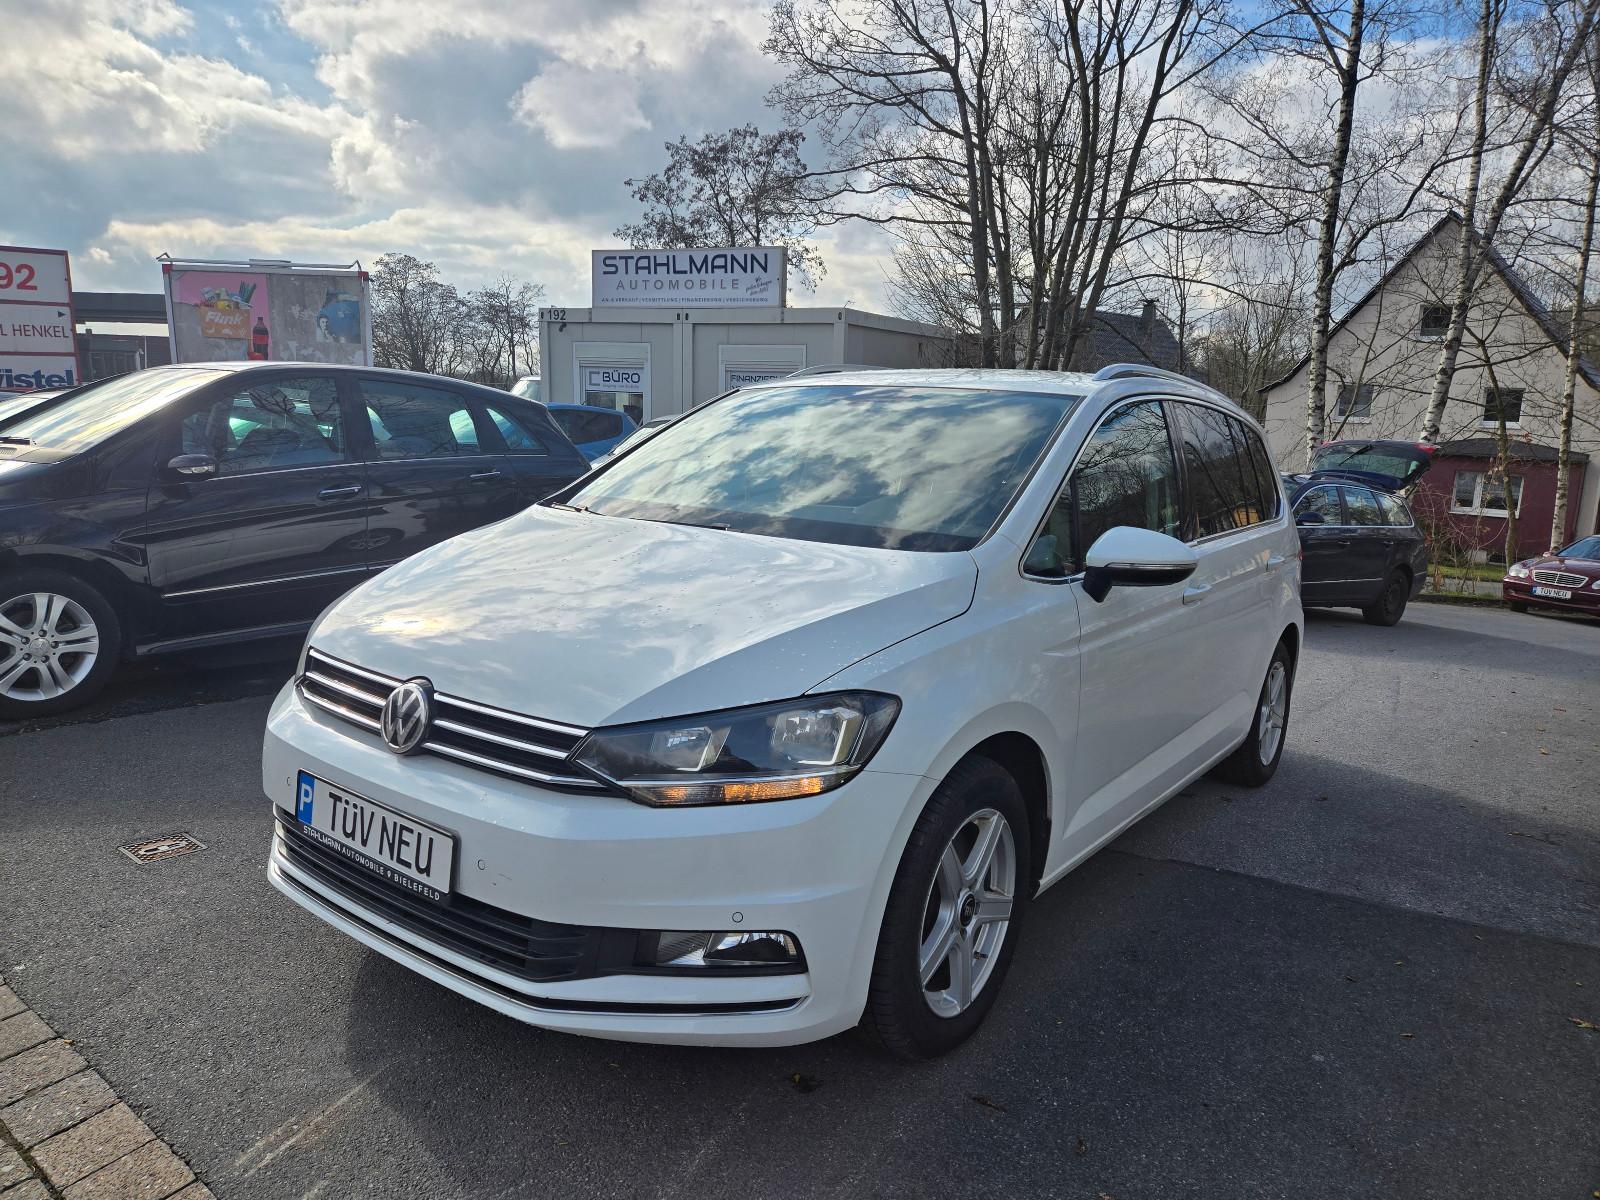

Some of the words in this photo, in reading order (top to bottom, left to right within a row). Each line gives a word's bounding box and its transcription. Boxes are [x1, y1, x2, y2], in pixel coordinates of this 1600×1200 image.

[602, 253, 768, 275] STAHLMANN
[616, 278, 740, 291] AUTOMOBILE
[547, 309, 566, 321] 192
[12, 324, 69, 338] HENKEL
[0, 368, 74, 389] istel
[602, 369, 640, 384] BÜRO
[731, 374, 784, 383] FINANZIE
[300, 783, 313, 811] P
[379, 815, 434, 878] NEU
[303, 825, 341, 852] STAHLMANN
[342, 845, 384, 876] AUTOMOBILE
[394, 873, 440, 901] BIELEFELD
